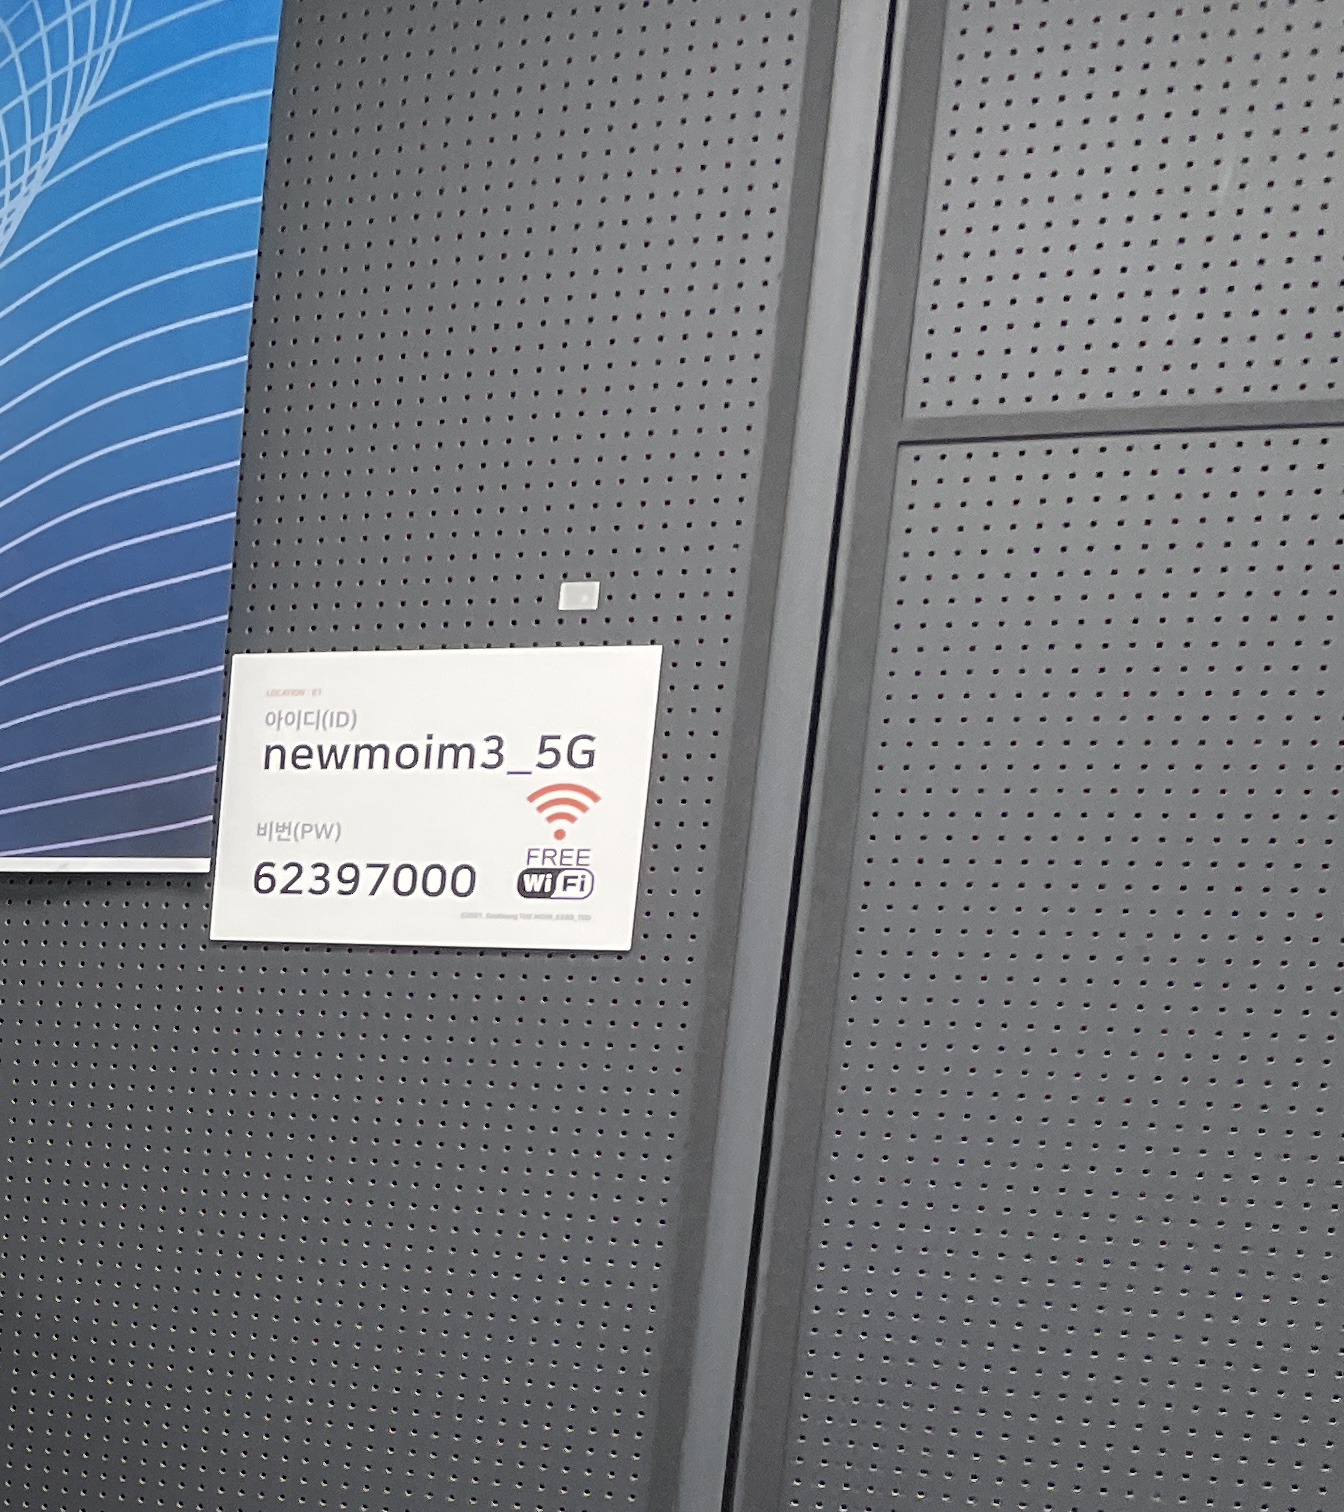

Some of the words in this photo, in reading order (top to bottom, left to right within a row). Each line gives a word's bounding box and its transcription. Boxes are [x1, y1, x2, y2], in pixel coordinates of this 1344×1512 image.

[264, 709, 358, 732] 아이디(ID)
[262, 733, 598, 776] newmoim3_5G
[255, 821, 342, 843] 비번(PW)
[525, 847, 592, 867] FREE
[252, 861, 478, 898] 62397000
